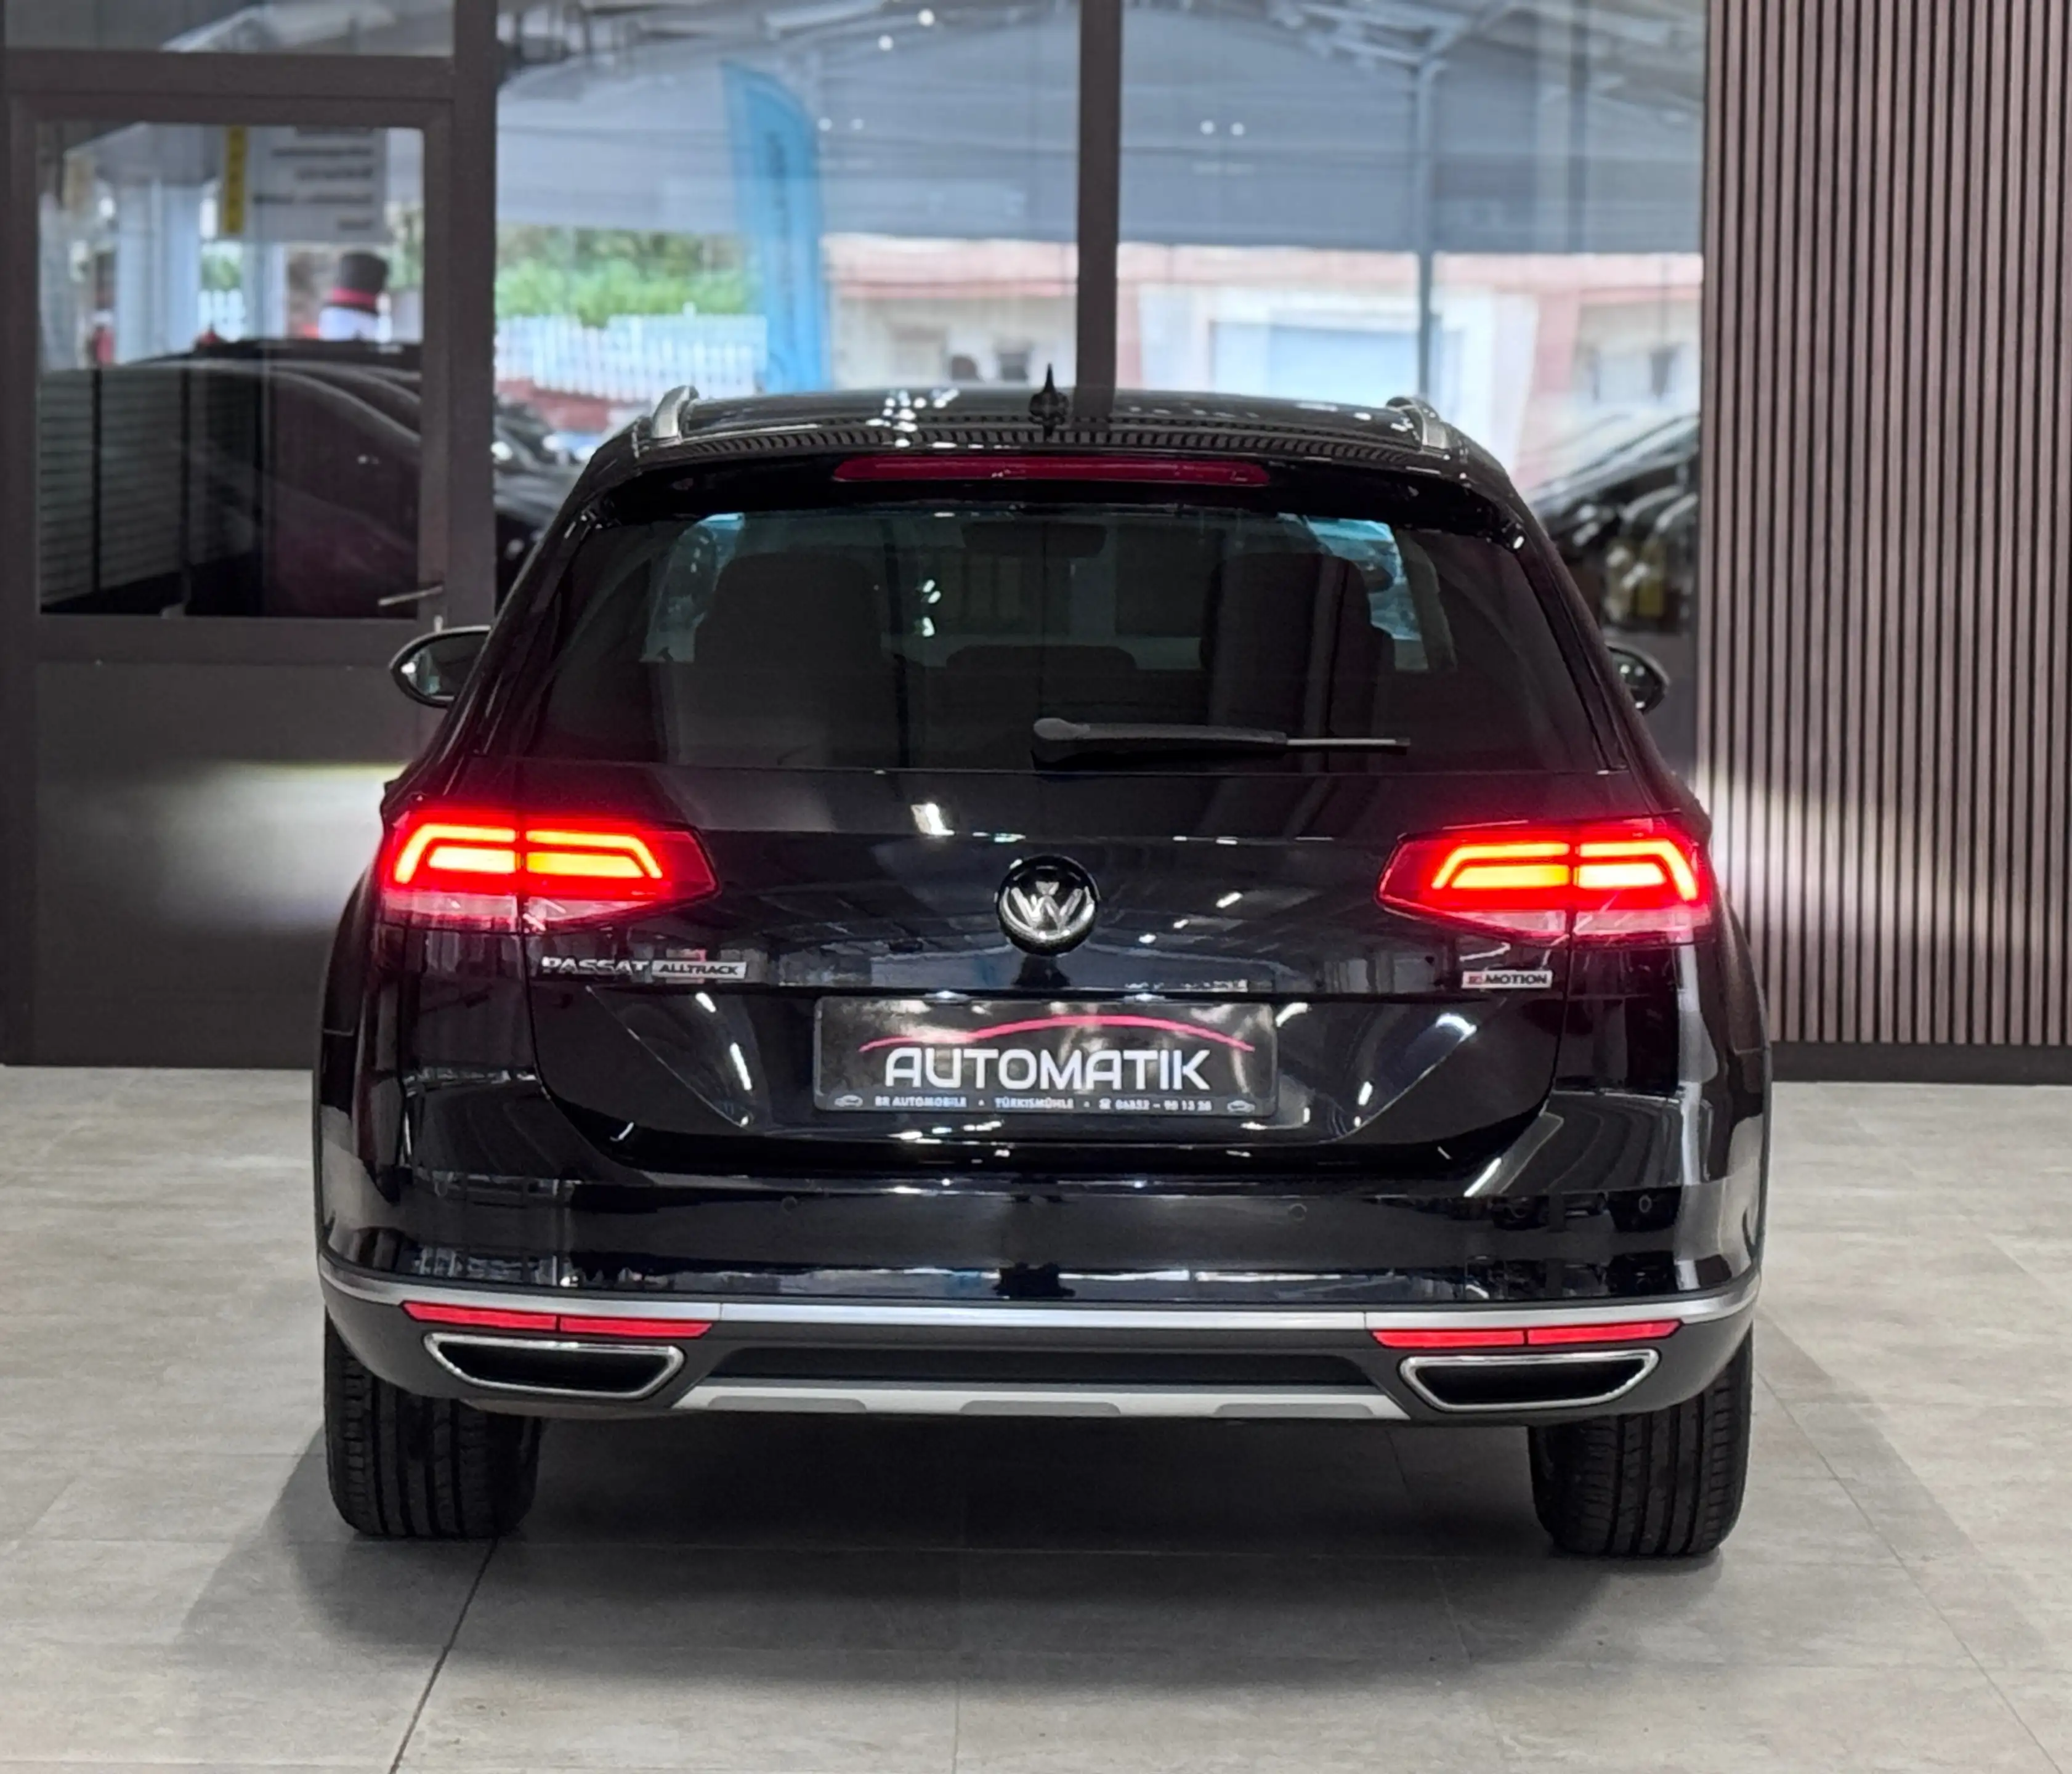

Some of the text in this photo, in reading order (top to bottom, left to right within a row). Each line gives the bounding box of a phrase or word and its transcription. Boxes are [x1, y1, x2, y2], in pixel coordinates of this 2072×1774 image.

[542, 956, 739, 976] PASSAT ALLTRACK
[884, 1048, 1210, 1090] AUTOMATIK
[892, 1095, 968, 1108] AUTOMOBILE
